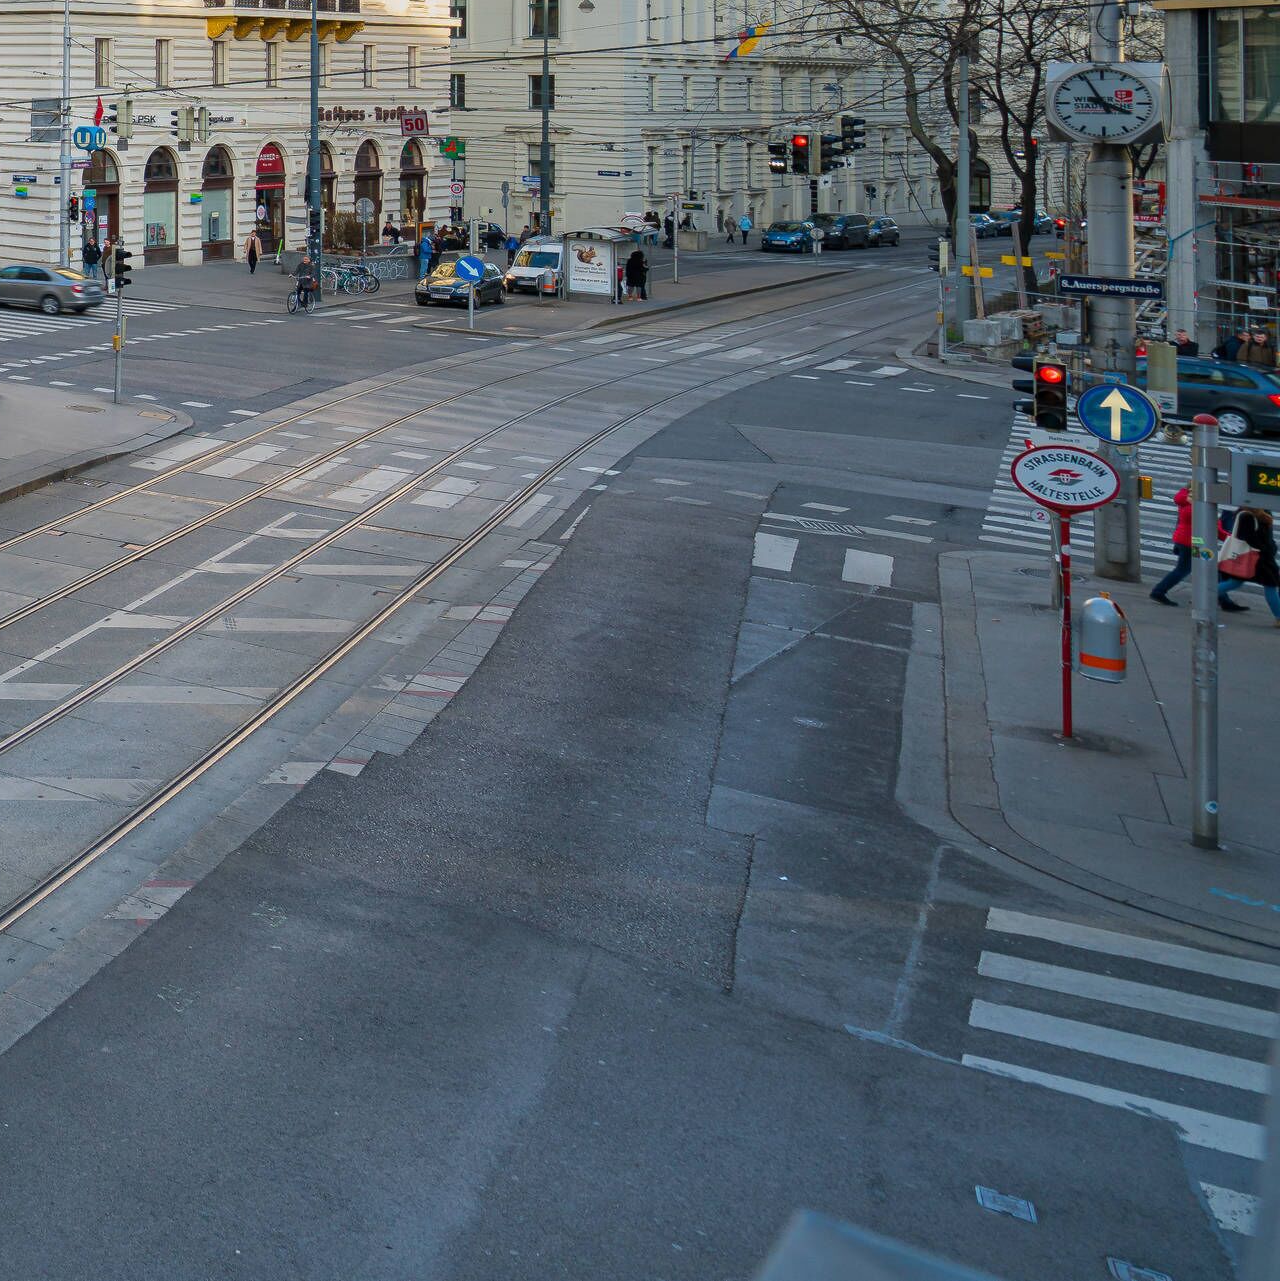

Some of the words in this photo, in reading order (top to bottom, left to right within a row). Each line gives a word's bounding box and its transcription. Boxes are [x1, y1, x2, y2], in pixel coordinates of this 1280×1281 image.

[404, 117, 425, 132] 50
[77, 132, 90, 148] U
[96, 132, 105, 148] U
[1024, 453, 1108, 477] STRASSENBAHN
[1028, 480, 1105, 501] HALTESTELLE
[1036, 511, 1045, 521] 2
